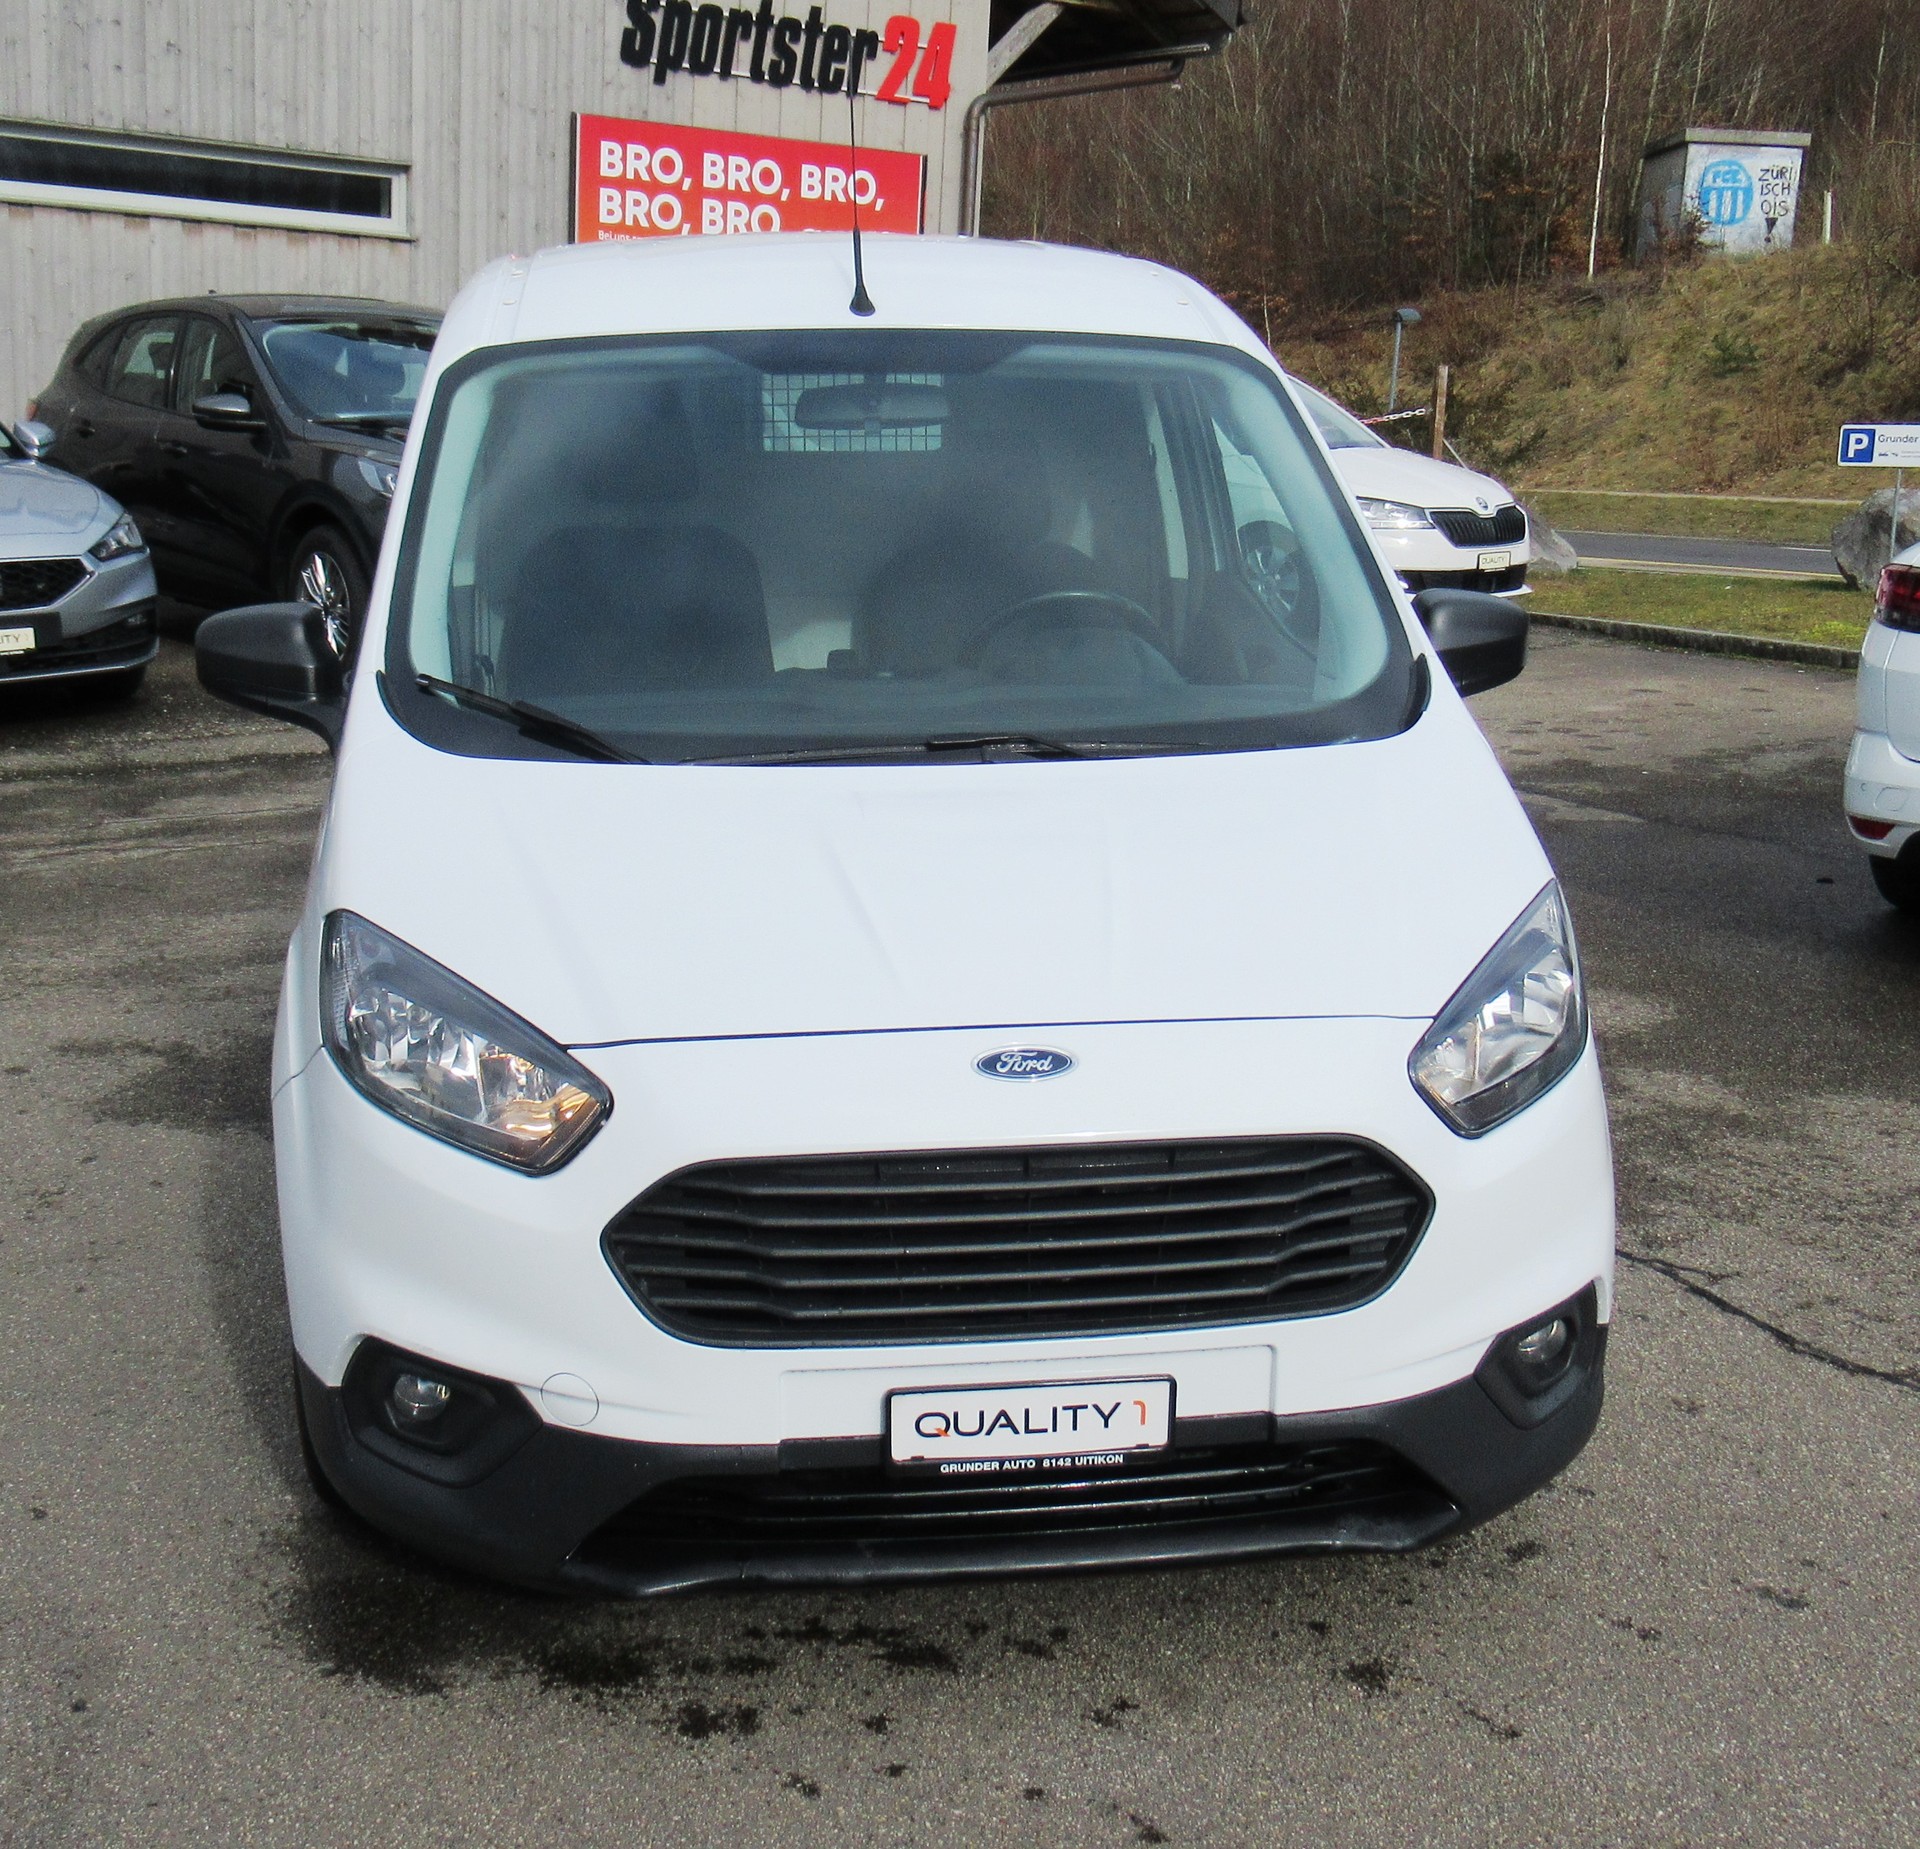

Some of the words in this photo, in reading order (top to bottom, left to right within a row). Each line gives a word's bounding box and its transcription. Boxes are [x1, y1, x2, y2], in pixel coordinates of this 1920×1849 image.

[599, 140, 692, 191] BRO,
[703, 152, 791, 202] BRO,
[800, 163, 885, 212] BRO,
[1760, 182, 1791, 196] ISCH
[598, 187, 691, 235] BRO,
[1847, 433, 1869, 458] P
[1877, 434, 1919, 443] Grunder
[996, 1052, 1054, 1073] Ford
[914, 1401, 1122, 1438] QUALITY
[1133, 1399, 1147, 1426] 1
[940, 1460, 1000, 1473] GRUNDER
[1003, 1458, 1036, 1470] AUTO
[1042, 1456, 1072, 1468] 8142
[1074, 1454, 1124, 1466] UITIKON
